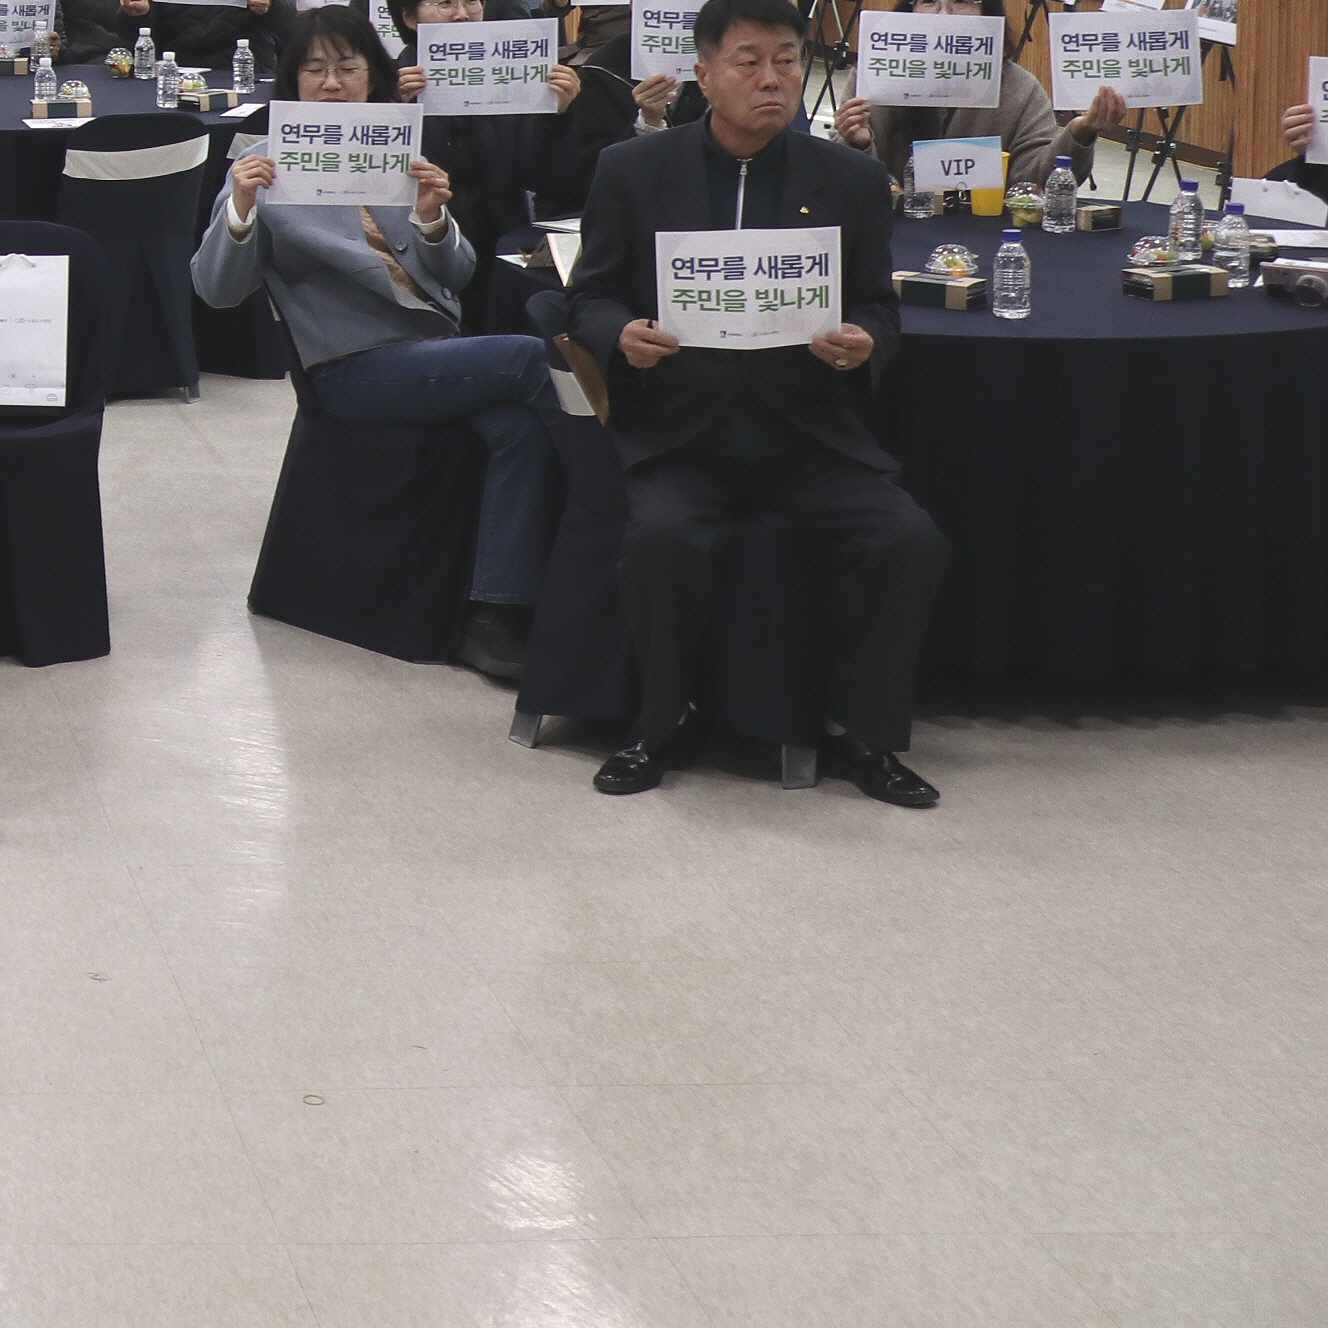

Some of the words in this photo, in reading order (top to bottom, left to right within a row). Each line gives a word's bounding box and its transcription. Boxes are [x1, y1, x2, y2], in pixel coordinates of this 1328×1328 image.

[12, 2, 50, 17] 새롭게
[644, 9, 697, 28] 연무를
[428, 41, 486, 62] 연무를
[491, 38, 549, 60] 새롭게
[641, 33, 698, 53] 주민을
[870, 31, 929, 52] 연무를
[934, 34, 994, 55] 새롭게
[1061, 32, 1122, 53] 연무를
[1127, 29, 1190, 51] 새롭게
[428, 66, 485, 87] 주민을
[491, 63, 548, 84] 빛나게
[868, 57, 927, 79] 주민을
[933, 58, 993, 79] 빛나게
[1061, 58, 1122, 79] 주민을
[1127, 56, 1191, 78] 빛나게
[281, 123, 344, 146] 연무를
[348, 124, 412, 146] 새롭게
[279, 150, 343, 173] 주민을
[347, 151, 411, 174] 빛나게
[940, 158, 975, 176] VIP
[671, 254, 745, 282] 연무를
[752, 251, 829, 279] 새롭게
[671, 286, 747, 313] 주민을
[753, 283, 829, 311] 빛나게
